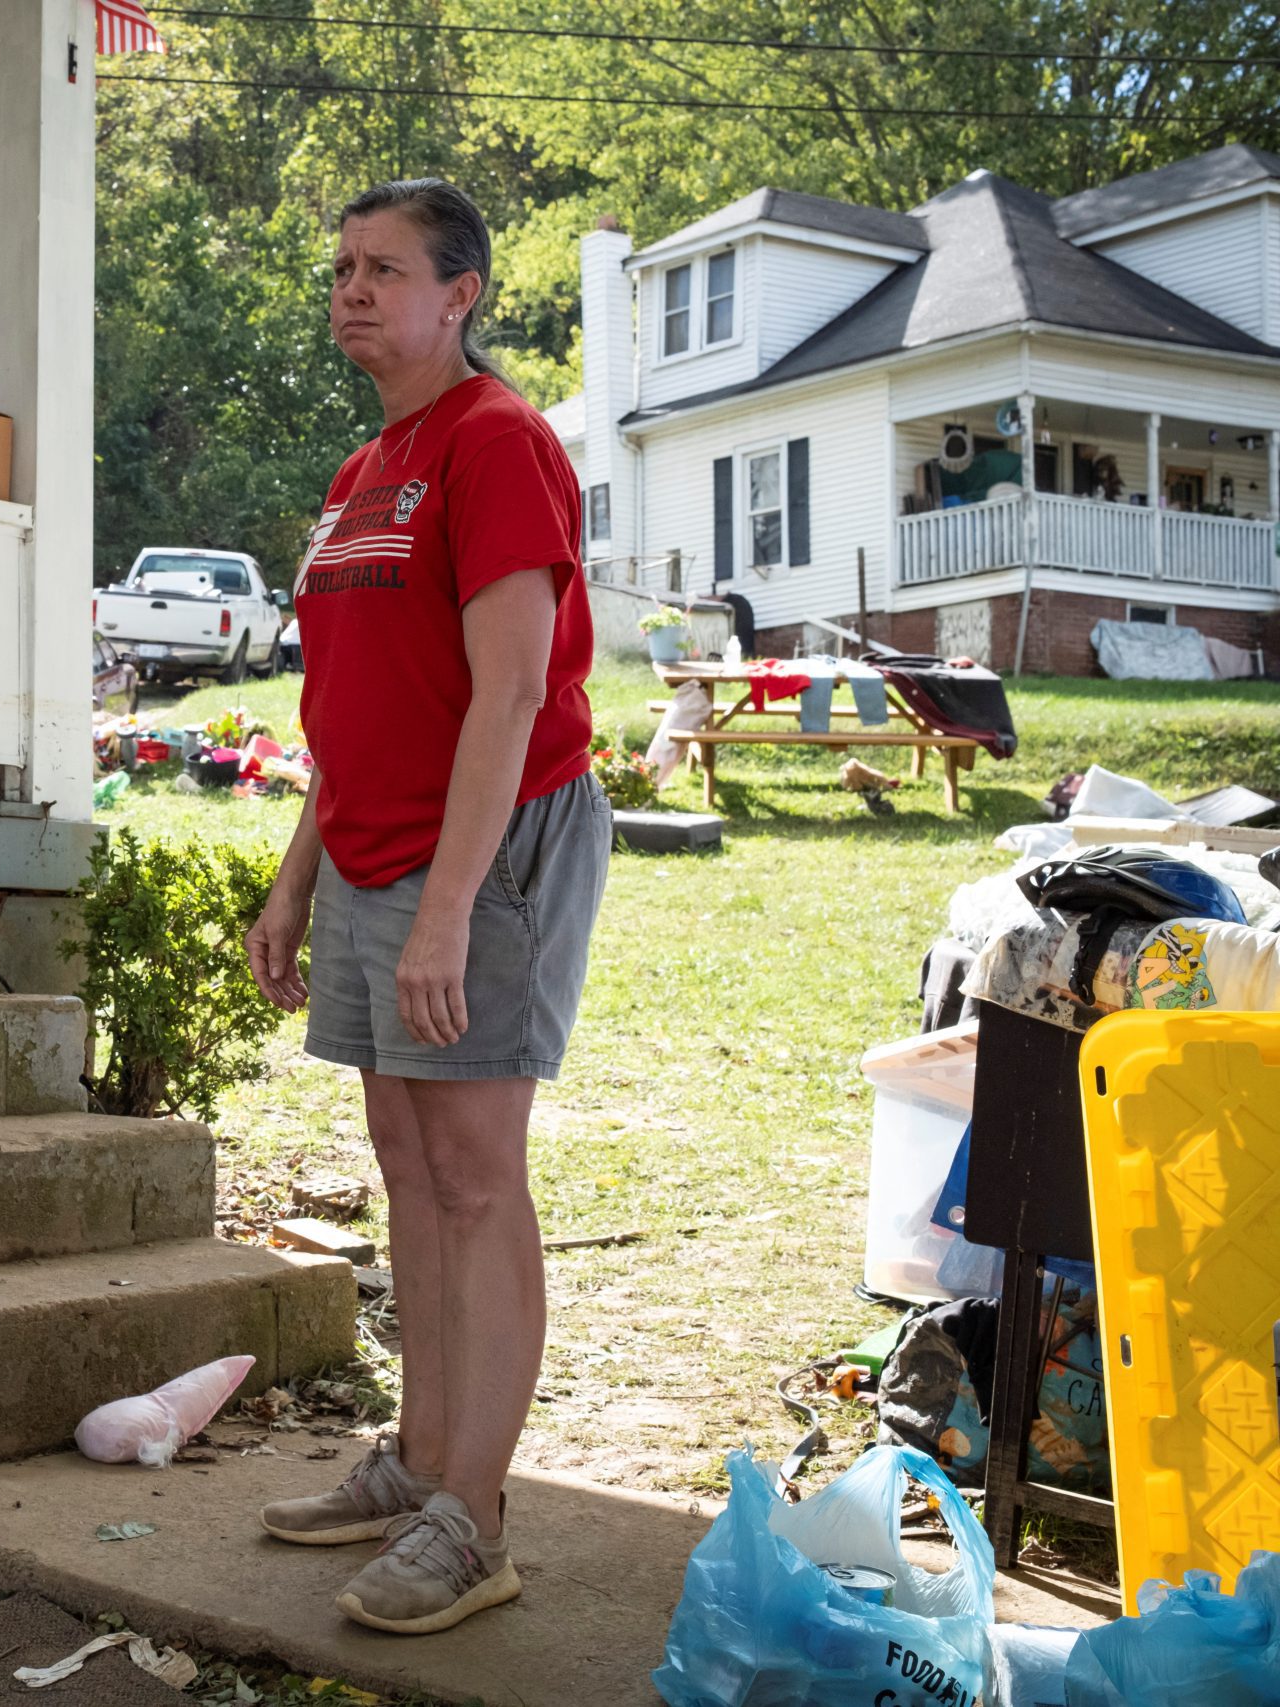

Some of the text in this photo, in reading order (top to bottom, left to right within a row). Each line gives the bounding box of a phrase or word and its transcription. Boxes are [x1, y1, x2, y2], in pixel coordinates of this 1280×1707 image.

[329, 511, 393, 538] WOLFPACK
[307, 565, 405, 594] VOLLEYBALL
[886, 1640, 945, 1693] FOOD
